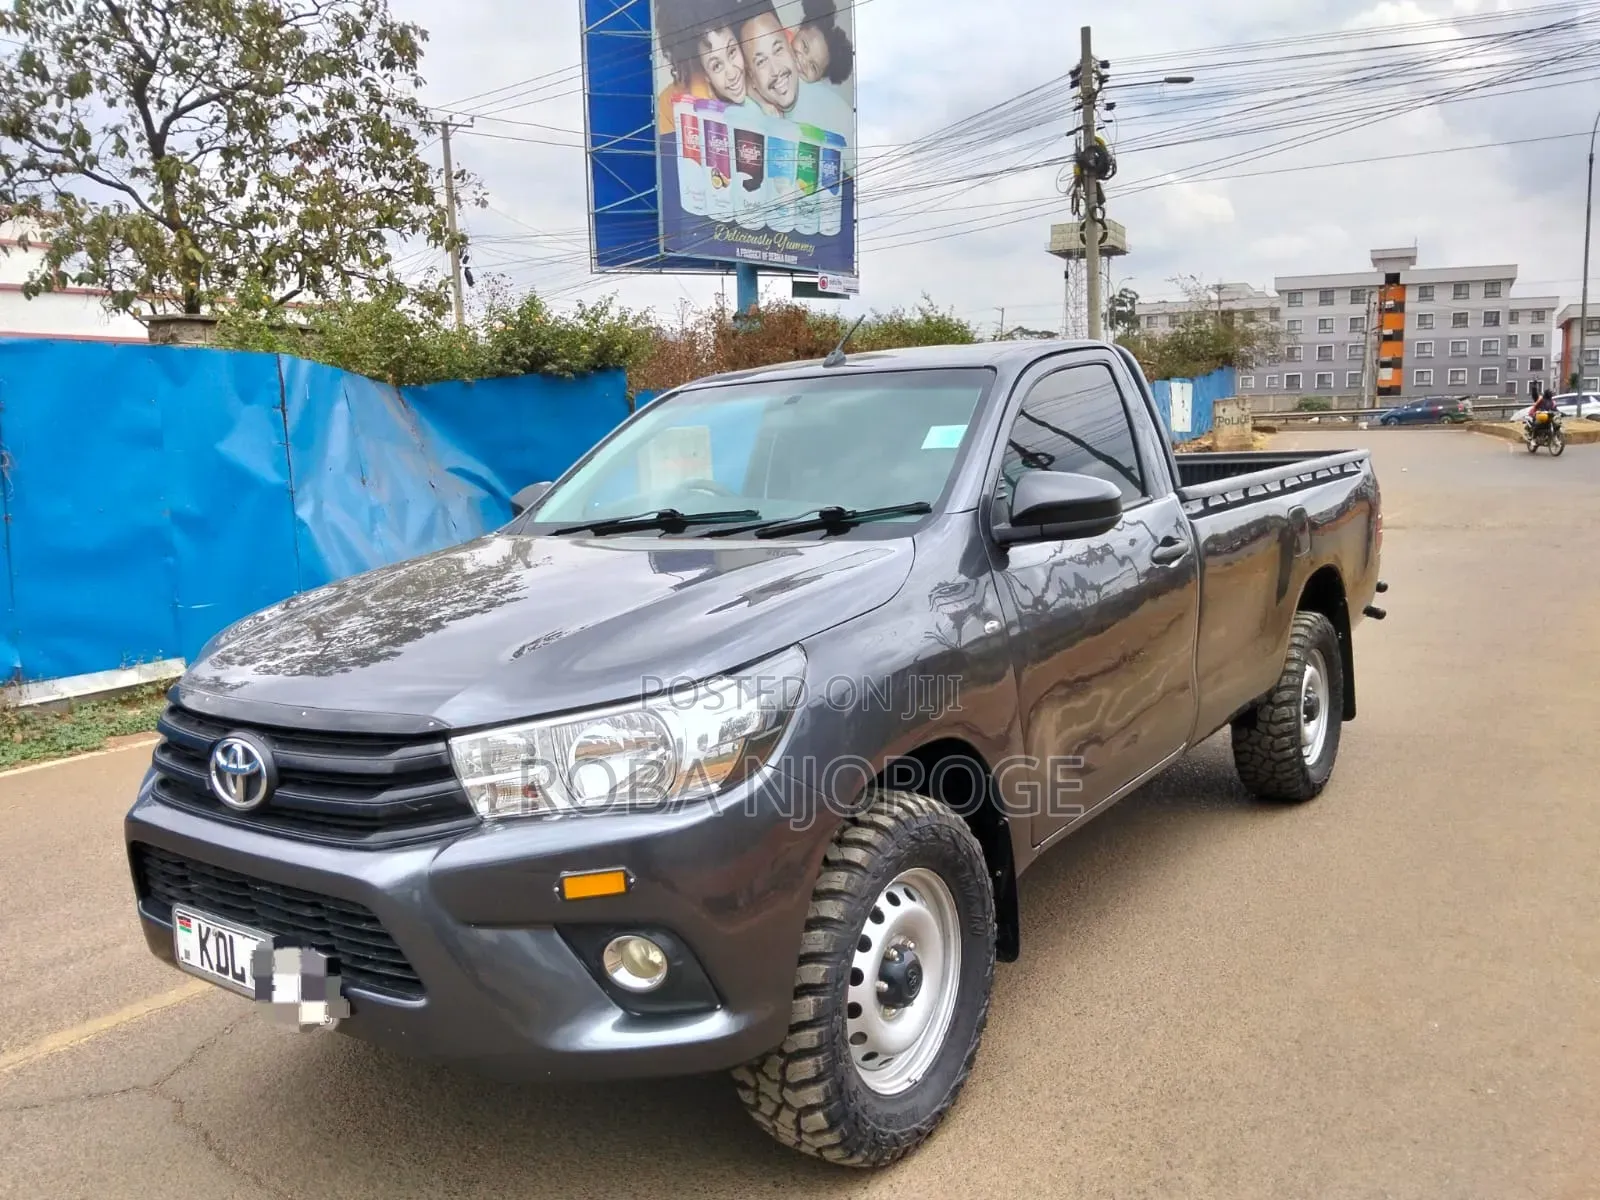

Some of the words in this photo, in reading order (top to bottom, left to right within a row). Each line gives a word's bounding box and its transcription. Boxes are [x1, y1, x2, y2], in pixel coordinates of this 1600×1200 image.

[713, 224, 772, 250] Deliciously
[773, 232, 815, 256] Yummy
[197, 922, 247, 984] KDL
